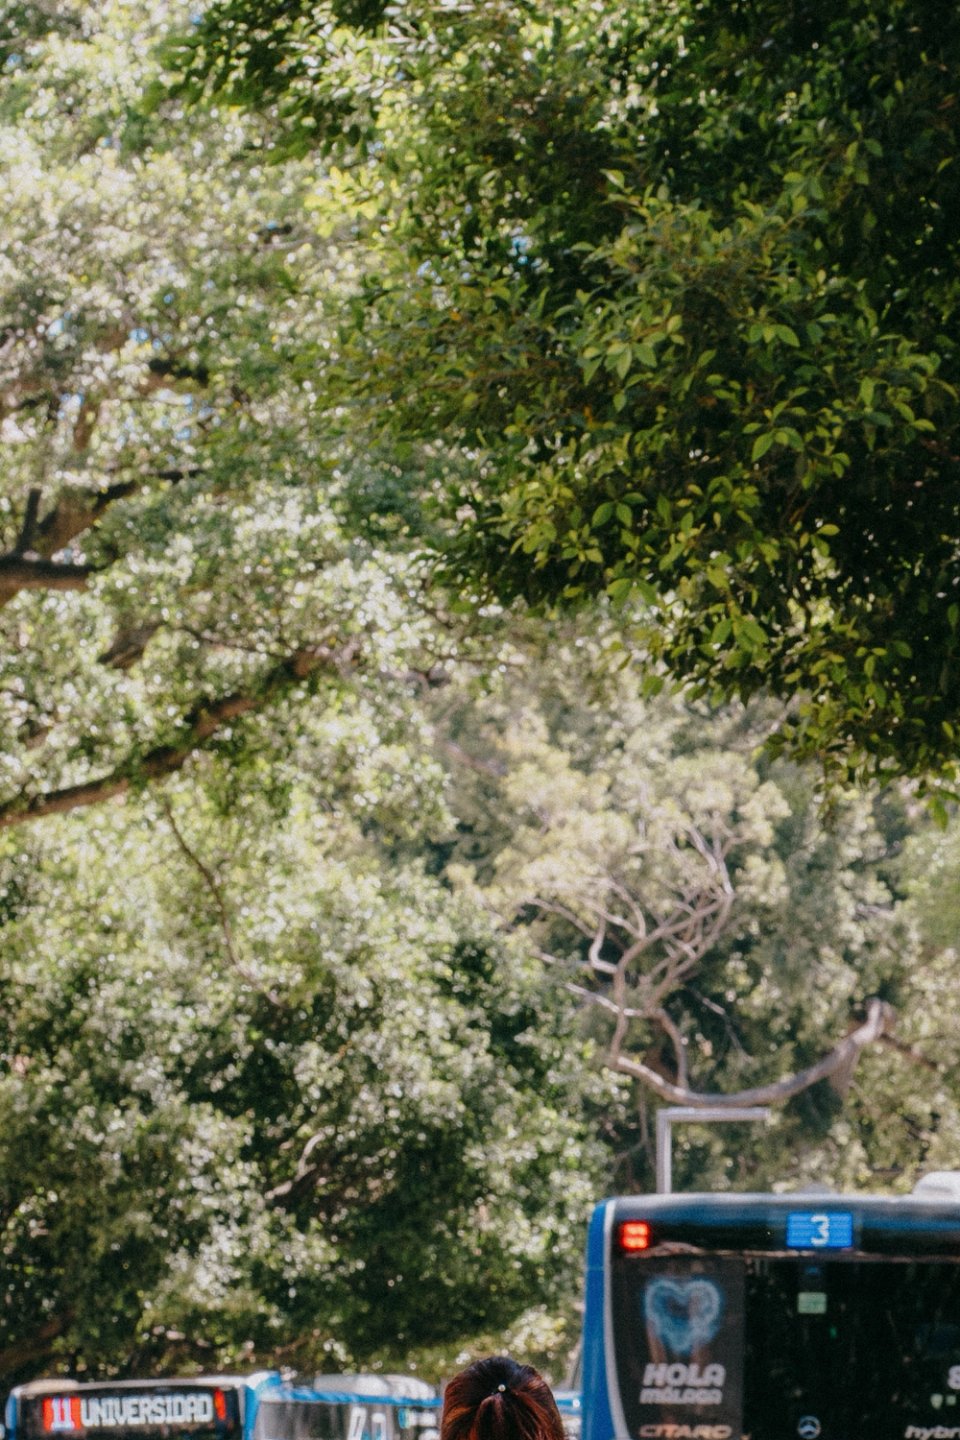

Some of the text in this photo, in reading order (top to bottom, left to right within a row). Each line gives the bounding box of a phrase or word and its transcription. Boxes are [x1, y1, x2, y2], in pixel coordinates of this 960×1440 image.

[810, 1213, 830, 1247] 3
[643, 1363, 727, 1388] HOLA
[50, 1393, 214, 1431] 11 UNIVERSIDAD
[639, 1424, 733, 1440] CITARO
